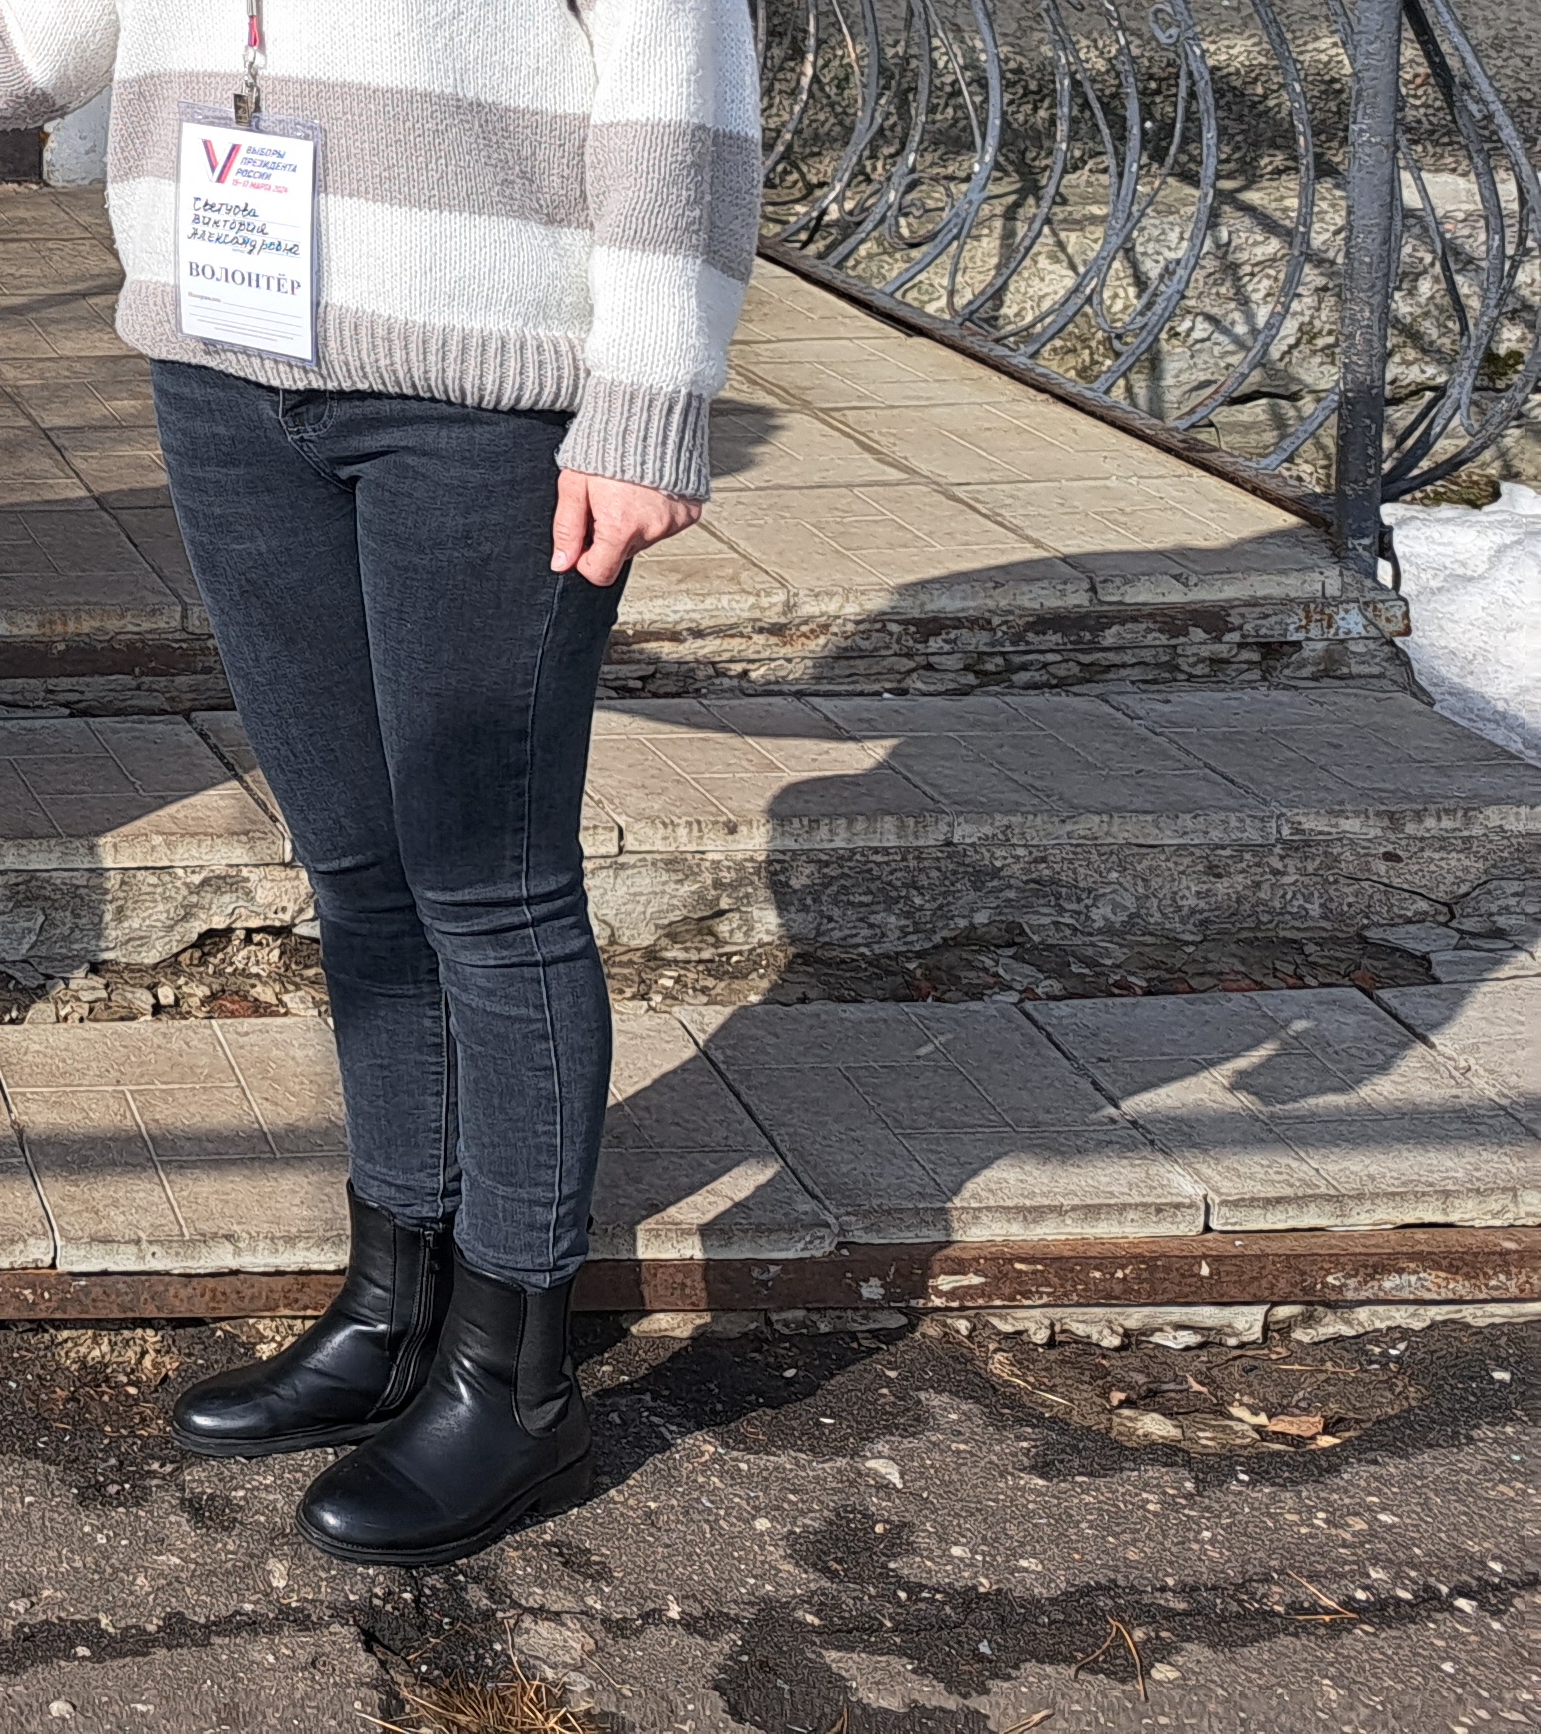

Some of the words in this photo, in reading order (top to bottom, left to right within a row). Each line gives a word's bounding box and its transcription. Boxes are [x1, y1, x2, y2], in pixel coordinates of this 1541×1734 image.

[246, 145, 287, 159] ВЫБОРЫ
[240, 157, 297, 173] ПРЕЗИДЕНТА
[235, 168, 272, 180] РОССИИ
[188, 260, 302, 296] ВОЛОНТЁР
